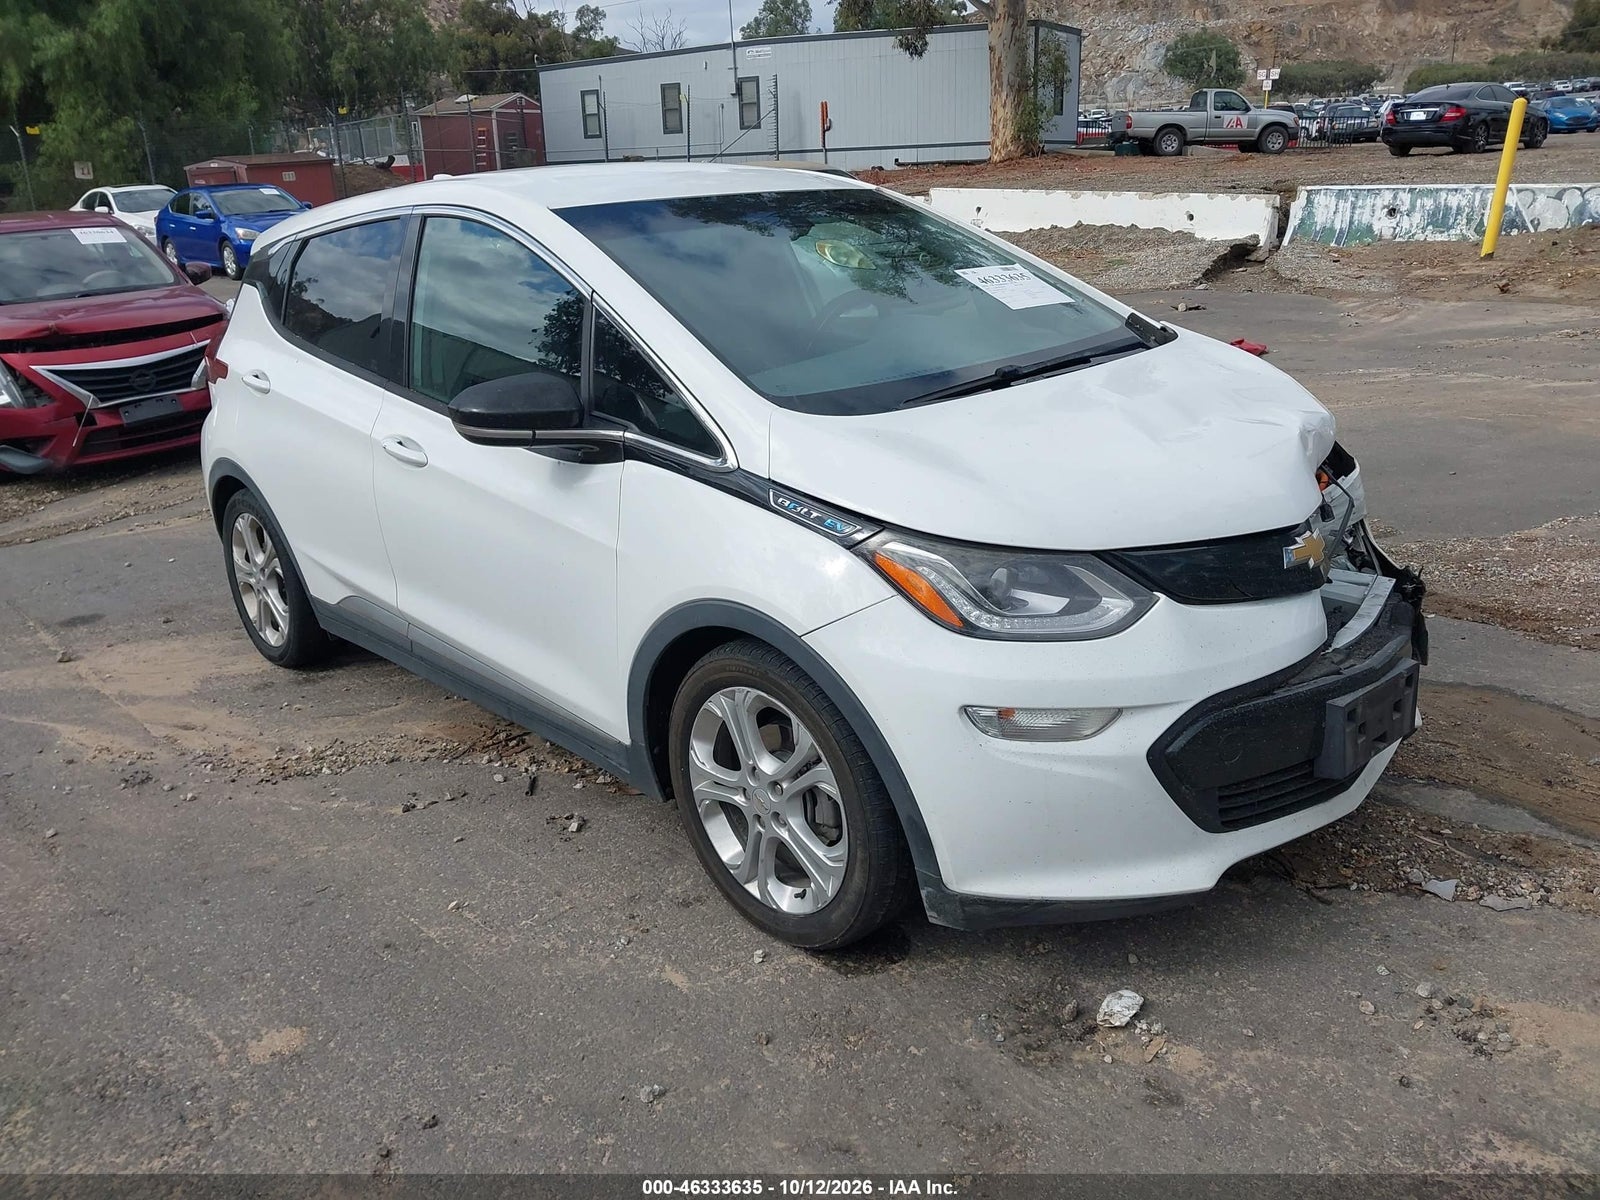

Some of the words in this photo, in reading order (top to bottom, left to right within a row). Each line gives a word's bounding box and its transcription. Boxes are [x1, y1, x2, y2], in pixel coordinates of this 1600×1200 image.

[977, 272, 1031, 285] 46333635
[777, 497, 822, 519] BOLT
[823, 517, 853, 533] EV
